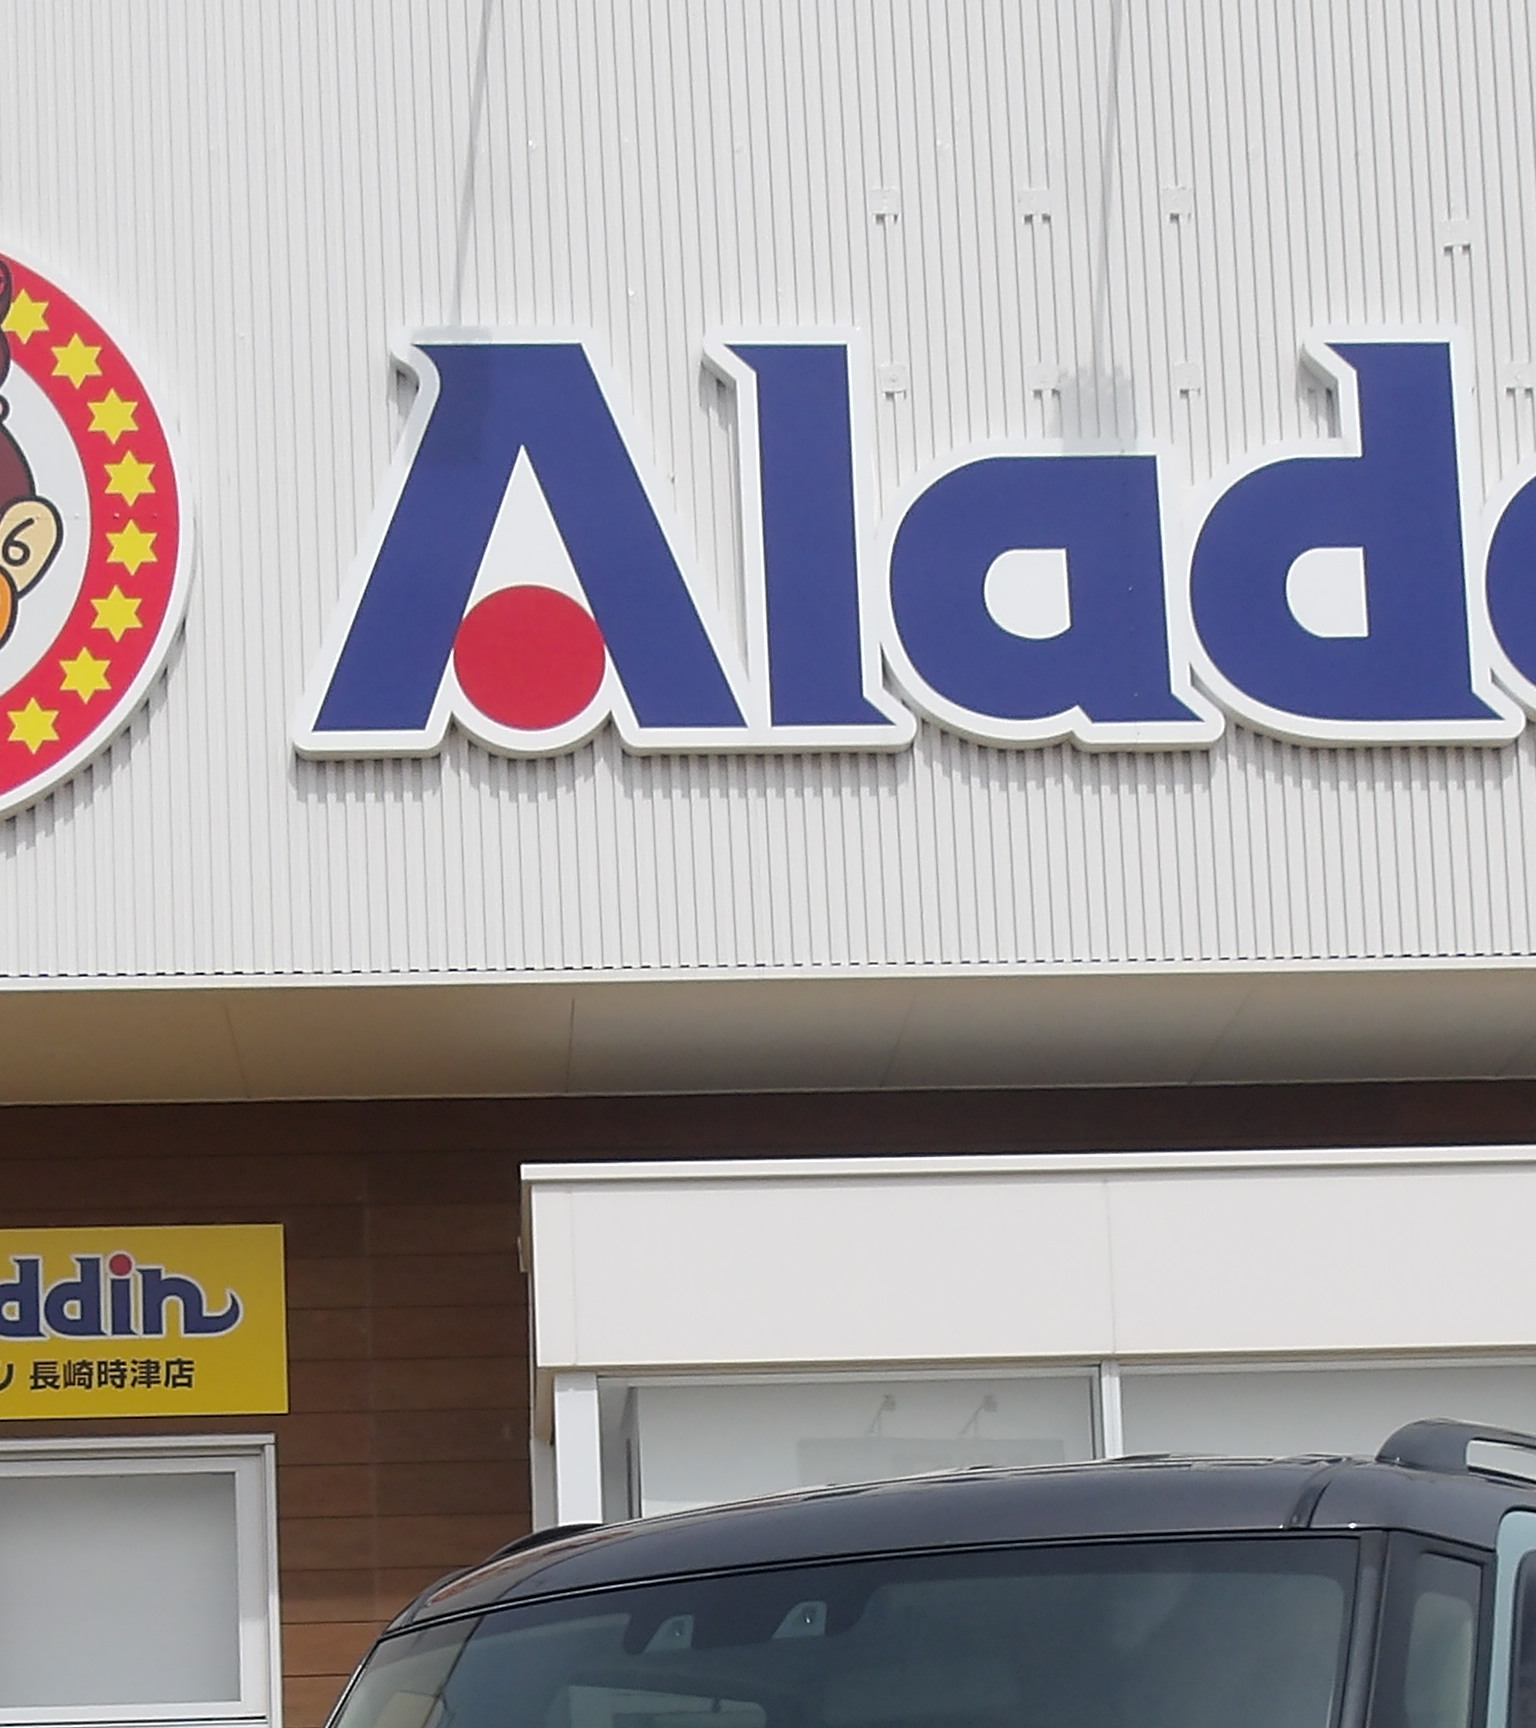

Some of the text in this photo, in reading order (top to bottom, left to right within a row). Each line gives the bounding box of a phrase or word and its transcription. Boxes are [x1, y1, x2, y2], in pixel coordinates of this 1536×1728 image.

[29, 1356, 196, 1391] 長崎時津店
